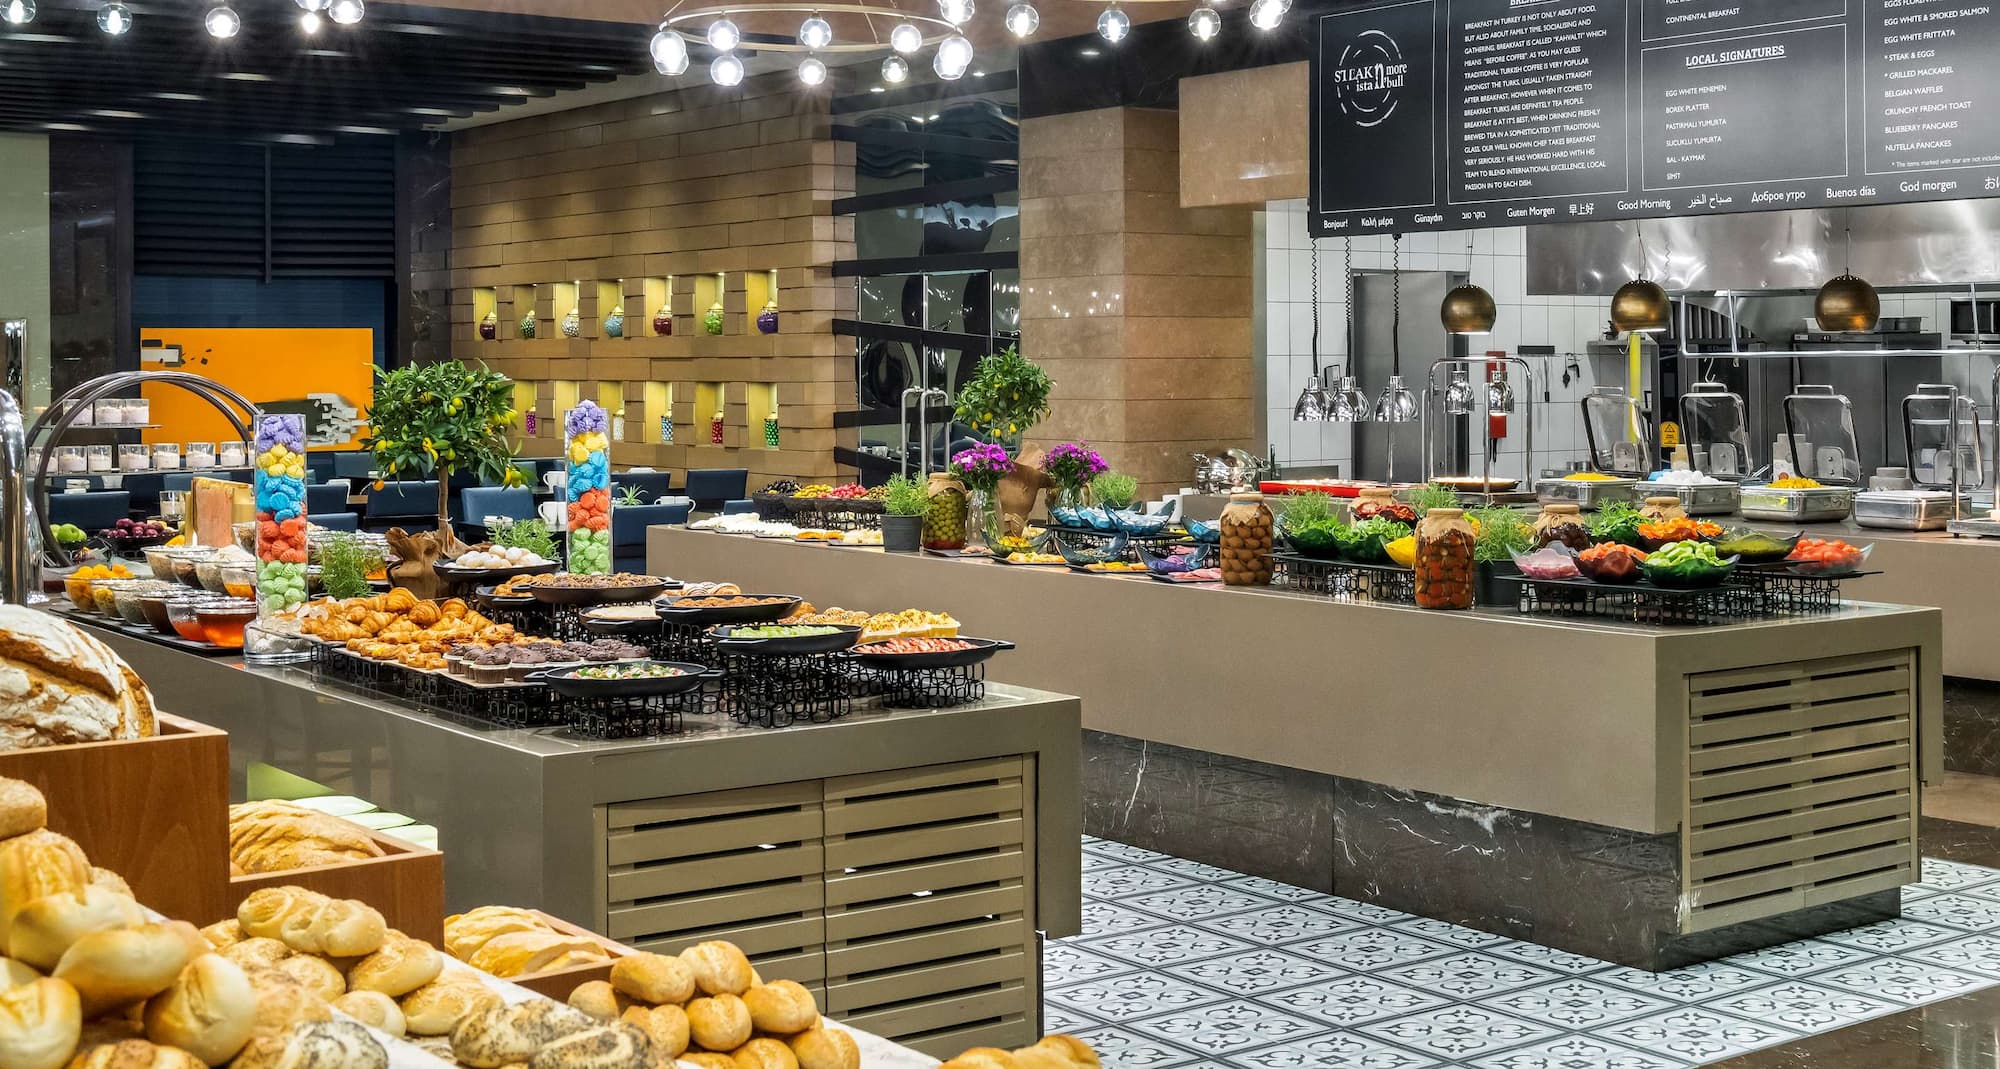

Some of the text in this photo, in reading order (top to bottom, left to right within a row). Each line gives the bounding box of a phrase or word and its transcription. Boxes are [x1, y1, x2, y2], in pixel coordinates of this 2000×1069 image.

[1884, 0, 1902, 8] EGGS
[1465, 20, 1493, 30] BREAKFAST
[1500, 16, 1521, 25] TURKEY
[1527, 13, 1540, 21] NOT
[1541, 11, 1557, 19] ONLY
[1557, 8, 1577, 17] ABOUT
[1665, 8, 1740, 24] CONTINENTAL BREAKFAST
[1884, 18, 1899, 26] EGG
[1900, 15, 1922, 24] WHITE
[1929, 10, 1958, 20] SMOKED
[1959, 6, 1990, 17] SALMON
[1496, 41, 1525, 51] BREAKFAST
[1531, 37, 1552, 46] CALLED
[1585, 30, 1606, 39] WHICH
[1884, 29, 1955, 44] EGG WHITE FRITTATA
[1464, 59, 1482, 67] MEANS
[1537, 50, 1550, 58] YOU
[1685, 45, 1785, 66] LOCAL SIGNATURES
[1889, 53, 1910, 62] STEAK
[1917, 50, 1935, 59] EGGS
[1334, 66, 1373, 82] STEAK
[1386, 64, 1407, 75] more
[1464, 69, 1499, 80] TRADITIONAL
[1500, 66, 1522, 75] TURKISH
[1523, 64, 1543, 72] COFFEE
[1549, 61, 1563, 69] VERY
[1564, 58, 1589, 67] POPULAR
[1889, 70, 1916, 80] GRILLED
[1464, 83, 1491, 92] AMONGST
[1491, 81, 1502, 89] THE
[1521, 76, 1545, 85] USUALLY
[1546, 74, 1564, 82] TAKEN
[1565, 71, 1593, 80] STRAIGHT
[1511, 90, 1538, 99] HOWEVER
[1538, 88, 1556, 96] WHEN
[1563, 85, 1583, 93] COMES
[1678, 88, 1698, 96] WHITE
[1884, 85, 1944, 98] BELGIAN WAFFLES
[1464, 107, 1492, 116] BREAKFAST
[1493, 105, 1510, 113] TURKS
[1521, 101, 1551, 110] DEFINITELY
[1685, 103, 1710, 112] PLATTER
[1884, 100, 1972, 116] CRUNCHY FRENCH TOAST
[1464, 120, 1492, 129] BREAKFAST
[1530, 114, 1548, 122] WHEN
[1549, 111, 1577, 120] DRINKING
[1577, 109, 1601, 117] FRESHLY
[1464, 133, 1486, 141] BREWED
[1551, 125, 1561, 133] YET
[1563, 122, 1601, 131] TRADITIONAL
[1884, 120, 1959, 134] BLUEBERRY PANCAKES
[1481, 144, 1494, 152] OUR
[1494, 143, 1508, 151] WELL
[1509, 141, 1532, 149] KNOWN
[1548, 138, 1565, 146] TAKES
[1565, 135, 1596, 144] BREAKFAST
[1885, 139, 1952, 152] NUTELLA PANCAKES
[1464, 158, 1477, 166] VERY
[1526, 152, 1551, 160] WORKED
[1552, 150, 1569, 158] HARD
[1569, 149, 1585, 157] WITH
[1681, 154, 1706, 162] KAYMAK
[1464, 170, 1479, 178] TEAM
[1506, 165, 1550, 174] INTERNATIONAL
[1587, 160, 1606, 168] LOCAL
[1827, 186, 1876, 198] Buenos días
[1900, 180, 1957, 192] God morgen
[1688, 194, 1732, 208] صباح الخير
[1752, 191, 1805, 203] Доброе утро
[1569, 203, 1594, 216] 早上好
[1618, 199, 1671, 210] Good Morning
[1507, 206, 1555, 218] Guten Morgen
[1324, 219, 1348, 230] Bonjour!
[1362, 217, 1376, 228] Καλή
